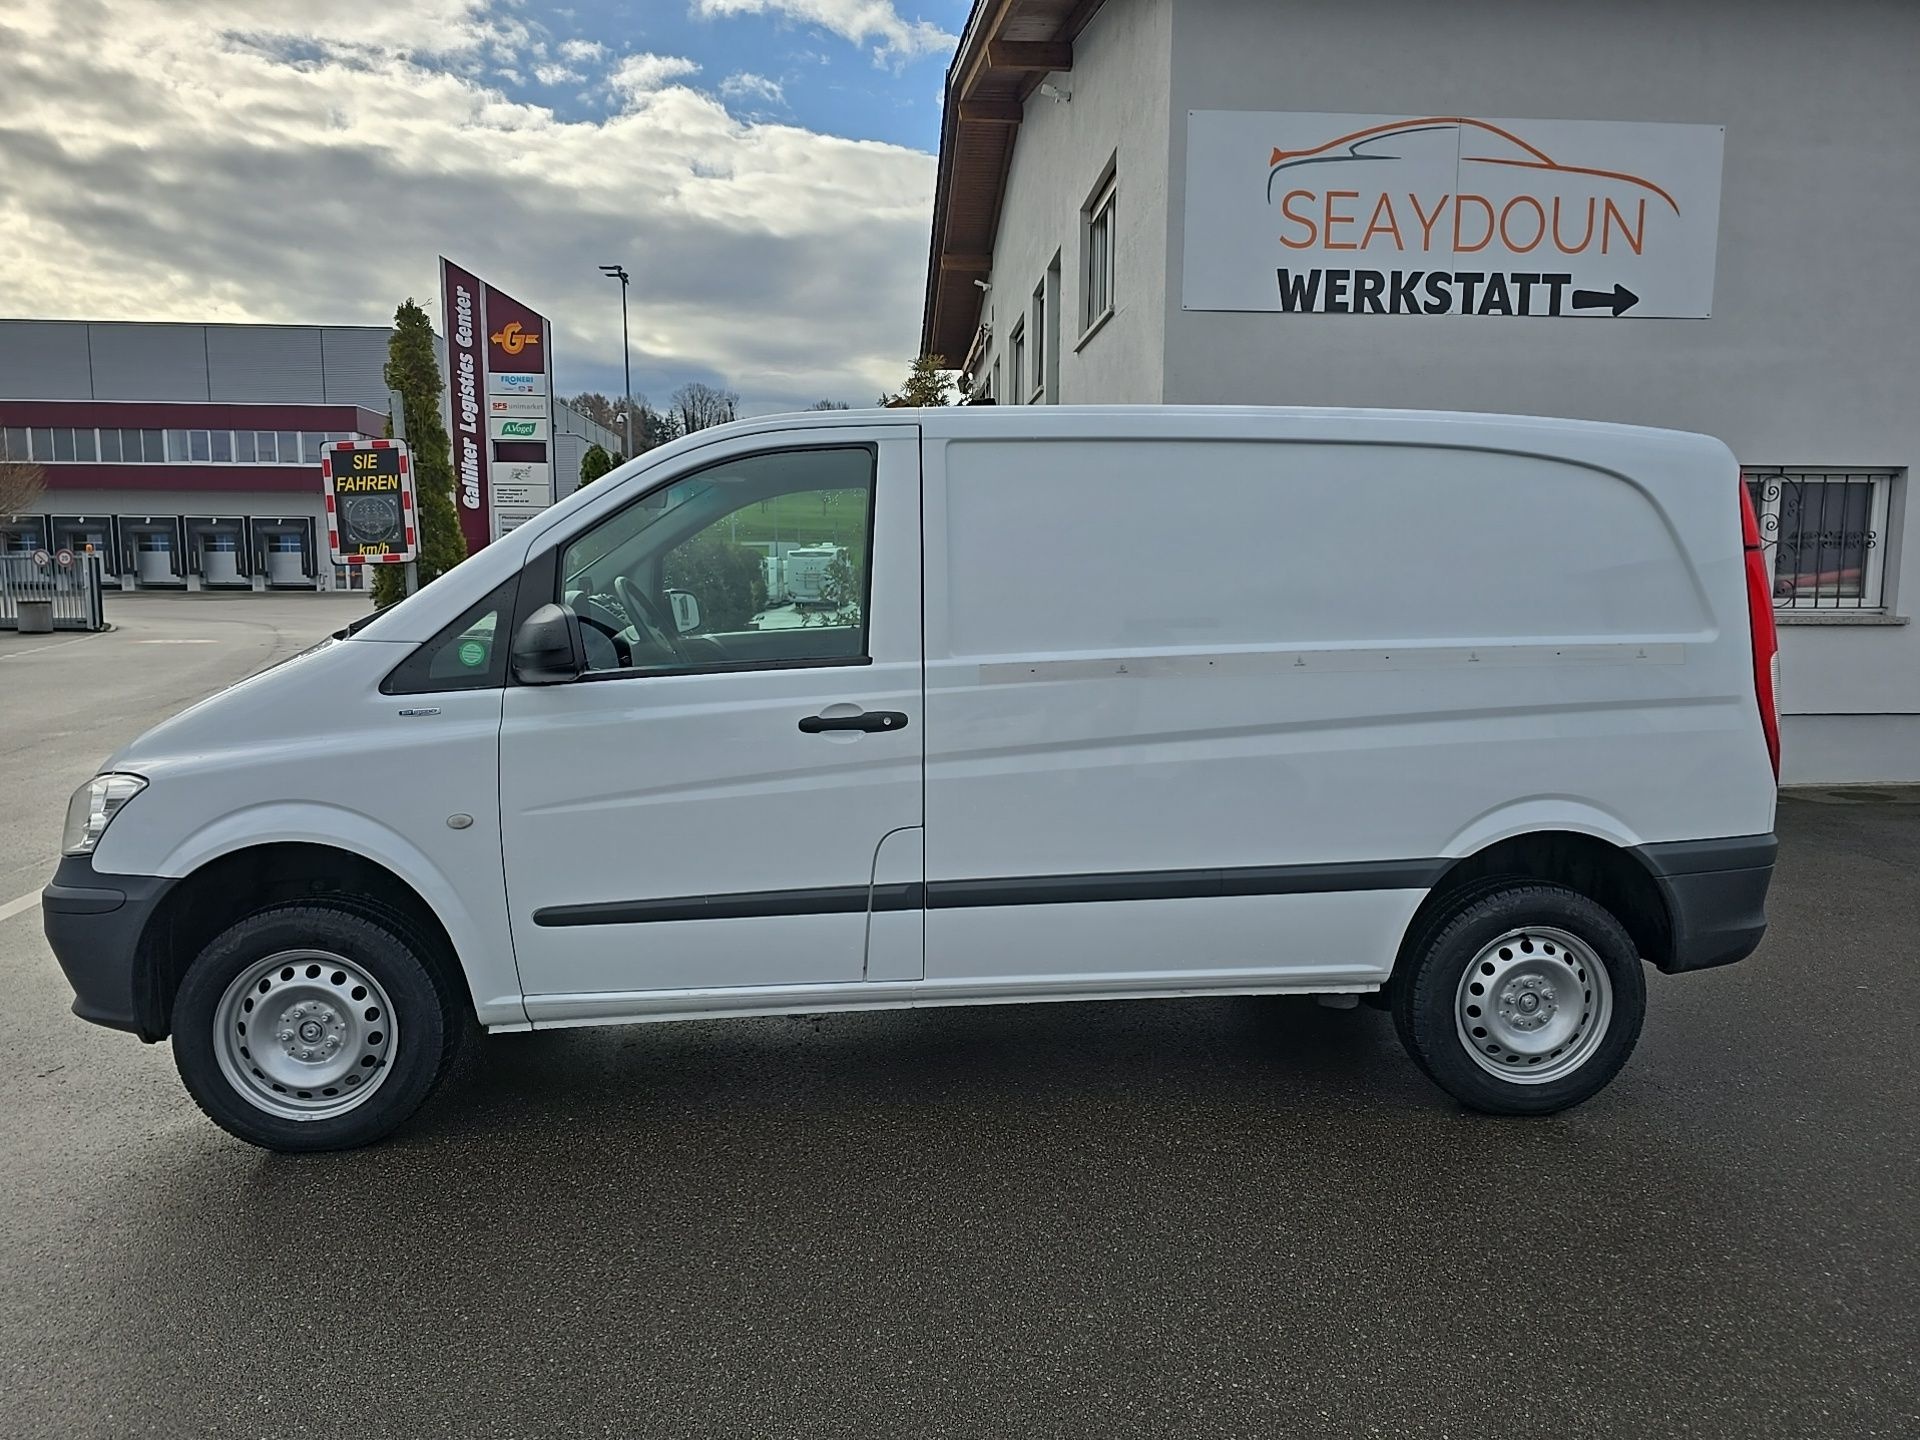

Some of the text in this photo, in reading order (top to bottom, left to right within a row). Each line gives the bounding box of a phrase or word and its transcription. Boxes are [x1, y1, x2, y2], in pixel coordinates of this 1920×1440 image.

[1279, 189, 1646, 255] SEAYDOUN
[1276, 268, 1572, 316] WERKSTATT
[455, 285, 480, 509] Galliker Logistics Center
[352, 454, 378, 470] SIE
[336, 474, 399, 492] FAHREN
[359, 542, 390, 555] km/h
